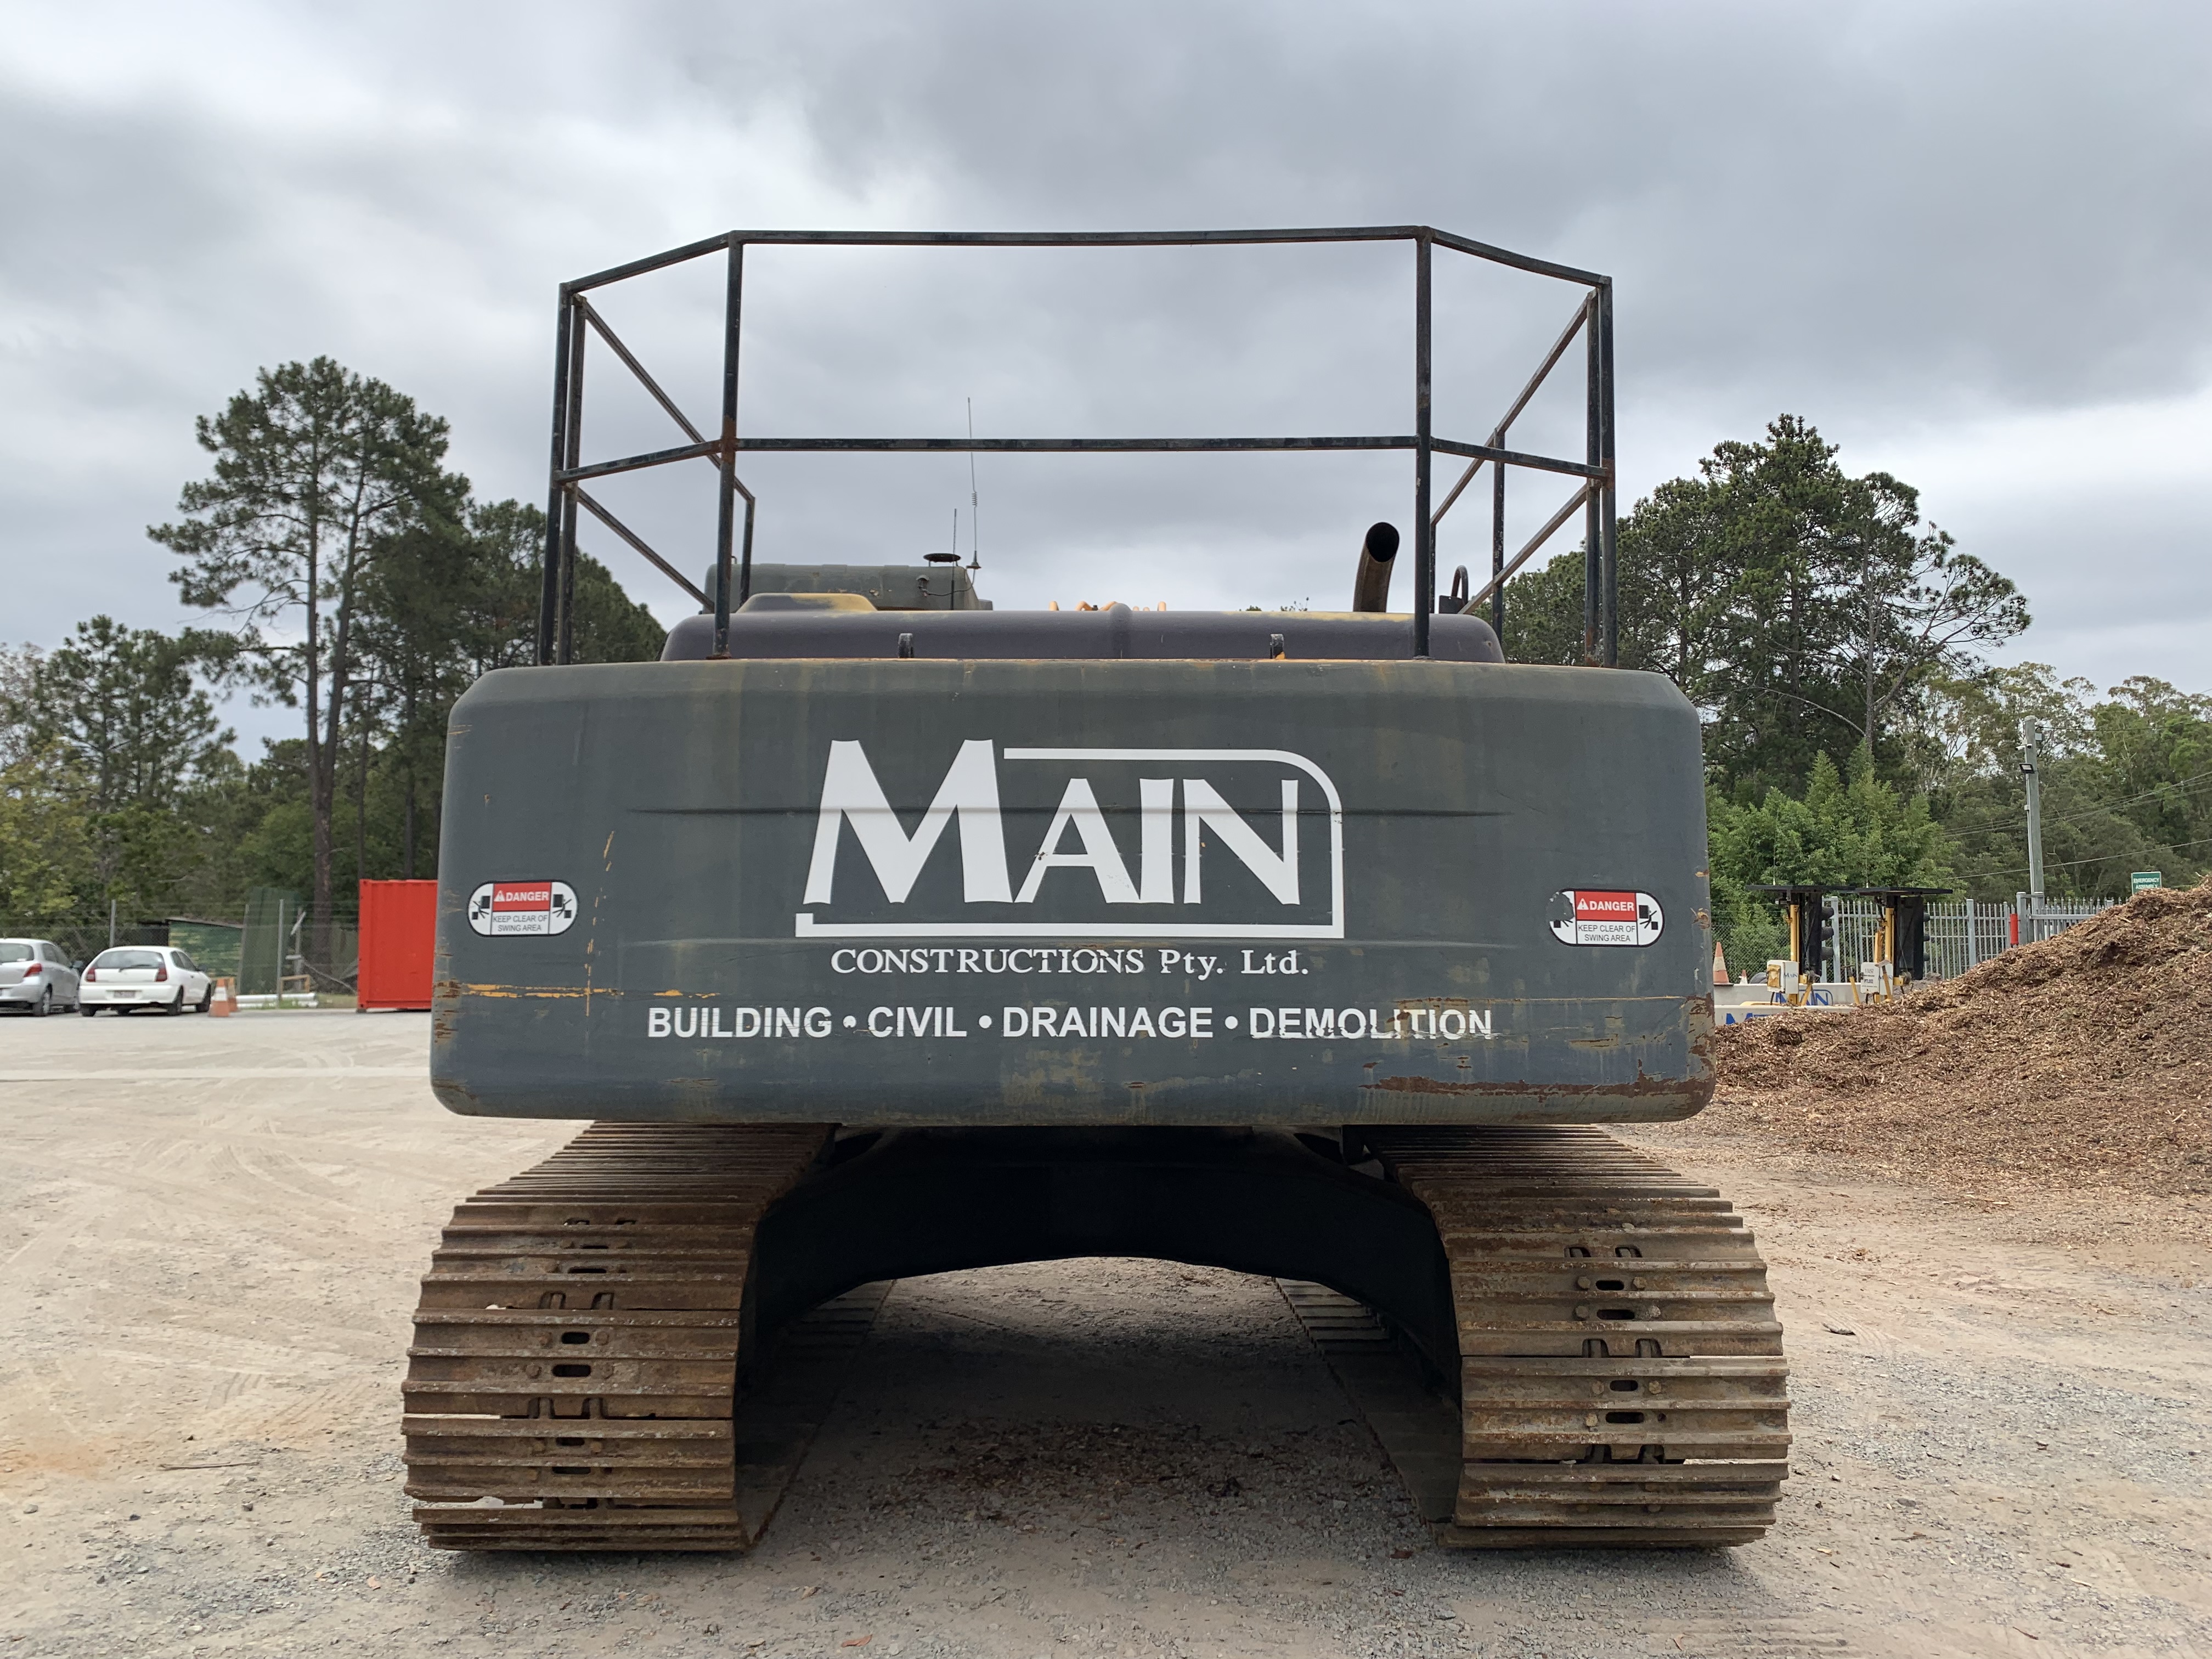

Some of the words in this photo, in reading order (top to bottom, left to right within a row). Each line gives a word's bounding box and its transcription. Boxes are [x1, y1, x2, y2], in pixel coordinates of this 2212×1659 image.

[505, 891, 549, 902] DANGER
[1589, 900, 1635, 912] DANGER
[831, 948, 1144, 974] CONSTRUCTIONS
[1158, 949, 1224, 981] Pty.
[1240, 949, 1309, 975] Ltd.
[647, 1006, 832, 1038] BUILDING
[868, 1006, 967, 1037] CIVIL
[1003, 1007, 1213, 1038] DRAINAGE
[1249, 1007, 1492, 1040] DEMOLITION
